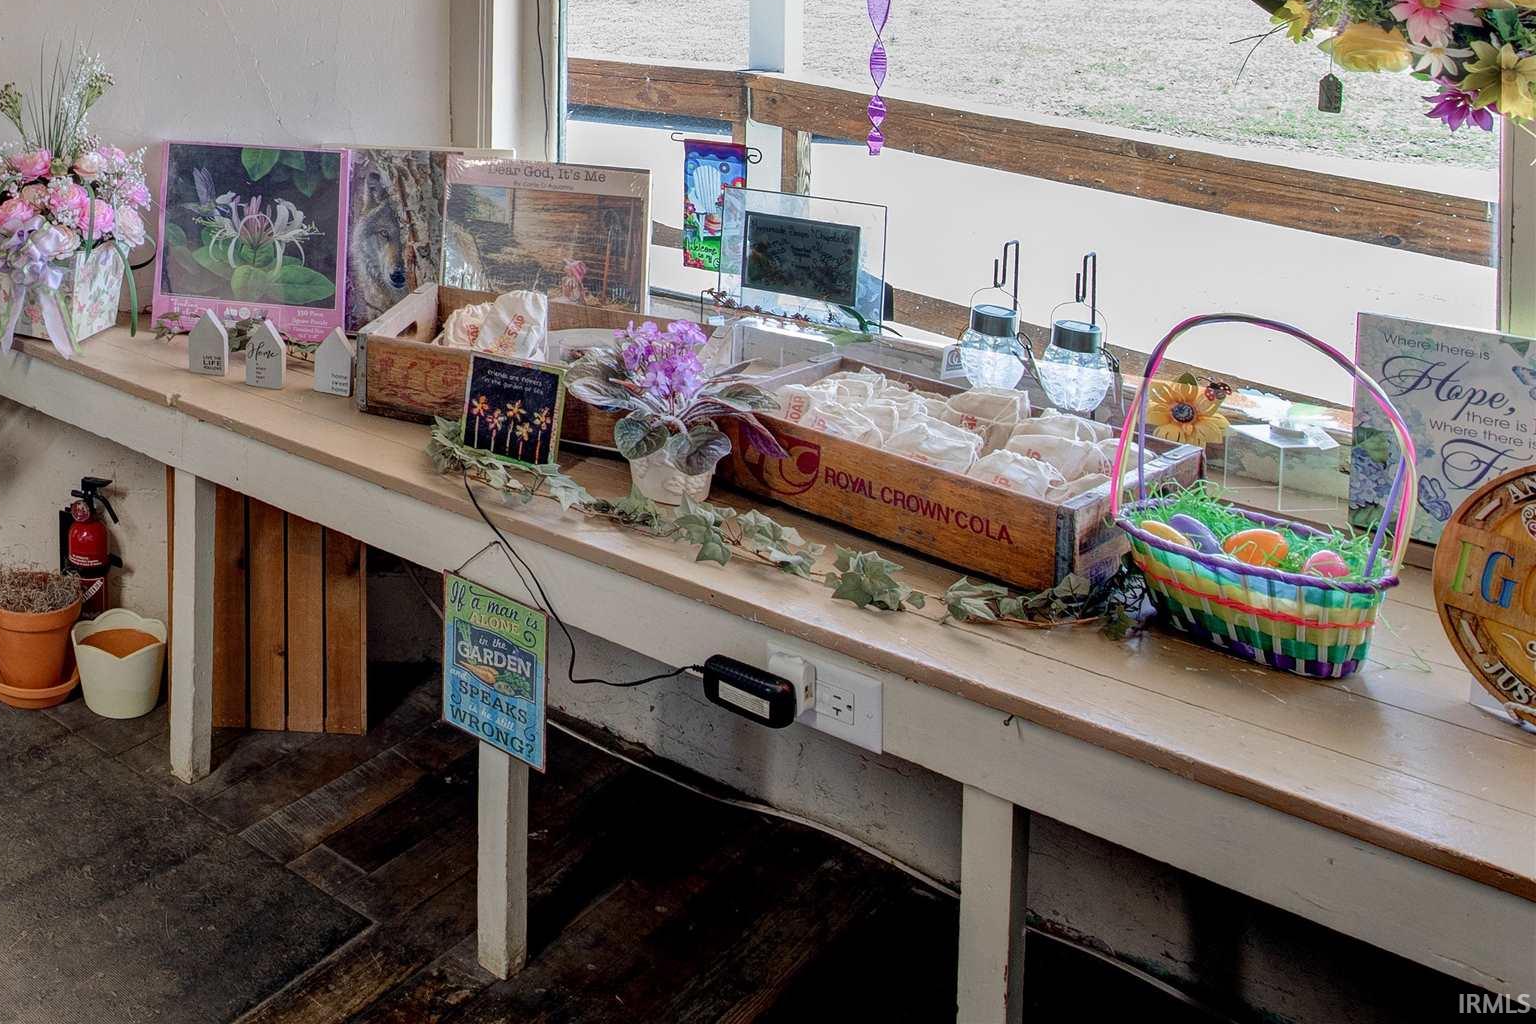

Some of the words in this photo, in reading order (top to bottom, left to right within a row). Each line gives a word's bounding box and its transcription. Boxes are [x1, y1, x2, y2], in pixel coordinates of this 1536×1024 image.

[488, 164, 520, 176] Dear
[523, 165, 554, 180] God,
[558, 168, 581, 181] It's
[584, 170, 606, 183] Me
[247, 340, 280, 362] Home
[1383, 332, 1431, 351] Where
[1436, 341, 1475, 358] there
[1479, 350, 1490, 361] is
[1377, 355, 1516, 421] Hope,
[789, 395, 803, 421] OAP
[1466, 411, 1511, 429] there
[1516, 420, 1528, 433] is
[1428, 417, 1478, 438] Where
[1483, 430, 1524, 448] there
[824, 466, 876, 500] ROYAL
[880, 485, 950, 523] CROWN
[954, 509, 1015, 545] COLA
[450, 580, 466, 612] If
[471, 596, 481, 610] a
[486, 598, 520, 622] man
[525, 613, 539, 632] is
[469, 611, 521, 636] ALONE
[478, 635, 489, 647] in
[492, 638, 508, 651] the
[457, 640, 532, 678] GARDEN
[458, 679, 528, 725] SPEAKS
[449, 703, 536, 759] WRONG?
